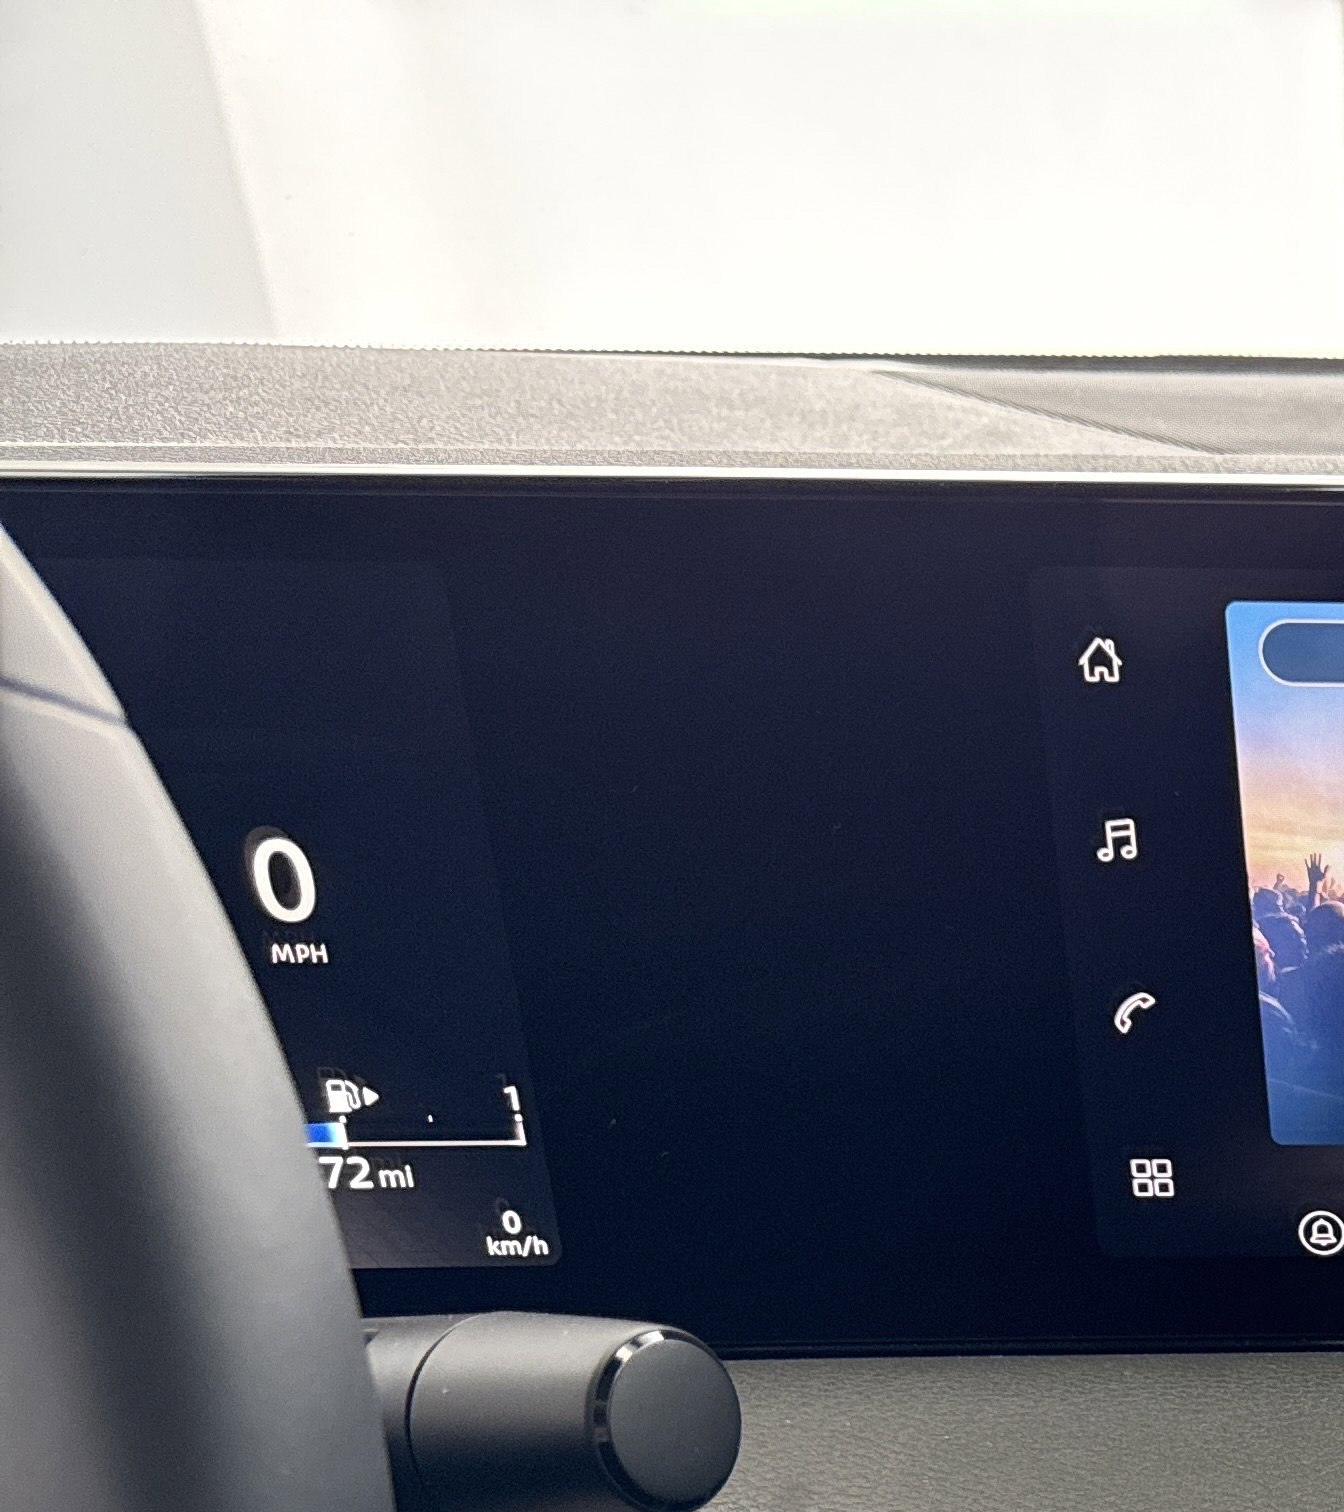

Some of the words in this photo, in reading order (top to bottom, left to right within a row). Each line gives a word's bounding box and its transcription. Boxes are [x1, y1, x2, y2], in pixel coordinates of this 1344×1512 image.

[253, 837, 316, 923] 0
[271, 943, 329, 965] MPH
[503, 1085, 521, 1112] 1
[378, 1164, 415, 1189] mi
[502, 1210, 522, 1235] 0
[486, 1235, 550, 1258] km/h
